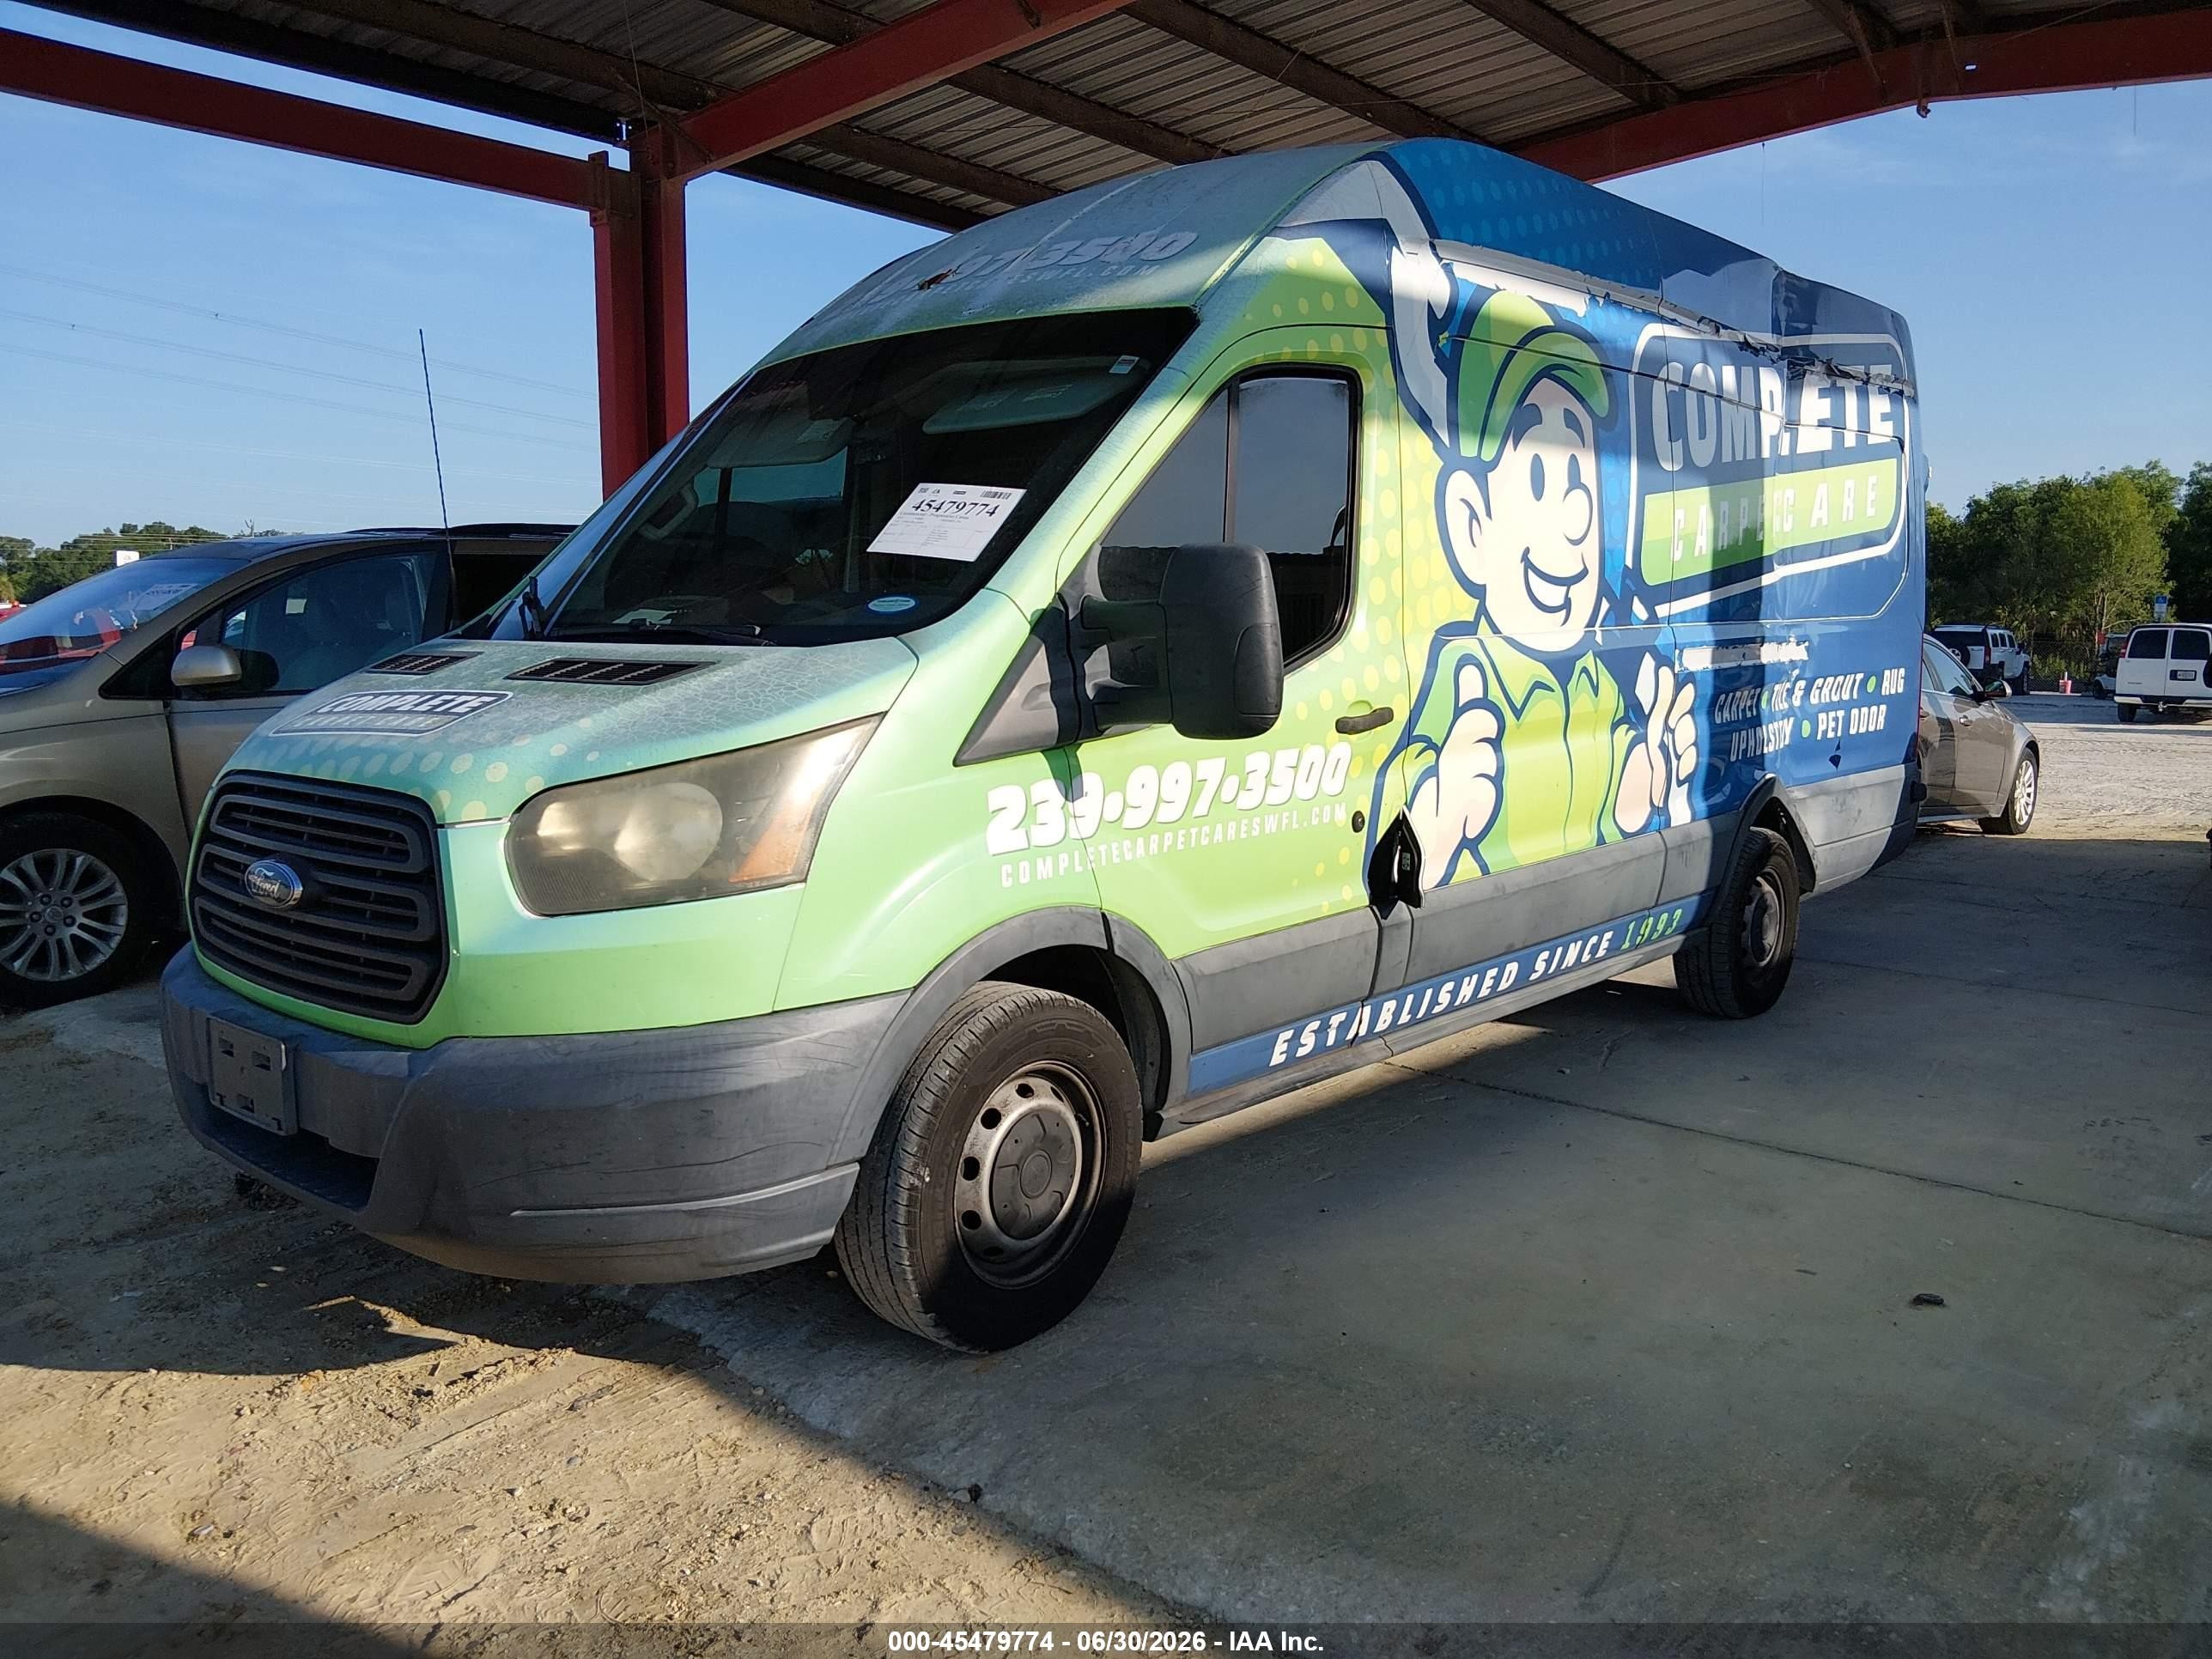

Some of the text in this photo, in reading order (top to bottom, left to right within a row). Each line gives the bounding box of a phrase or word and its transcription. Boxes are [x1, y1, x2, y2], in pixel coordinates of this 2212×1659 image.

[912, 499, 1000, 517] 45479774
[1782, 475, 1878, 532] CARE
[317, 695, 498, 714] COMPLETE
[1714, 687, 1761, 724] CARPET
[1792, 679, 1807, 707] &
[1810, 672, 1864, 705] GROUT
[1881, 667, 1905, 696] RUG
[1816, 709, 1845, 740] PET
[1849, 704, 1887, 735] ODOR
[1000, 803, 1347, 888] COMPLETECARPETCARESWFL.COM
[248, 867, 282, 898] Ford
[1268, 908, 1683, 1067] ESTABLISHED SINCE 1993
